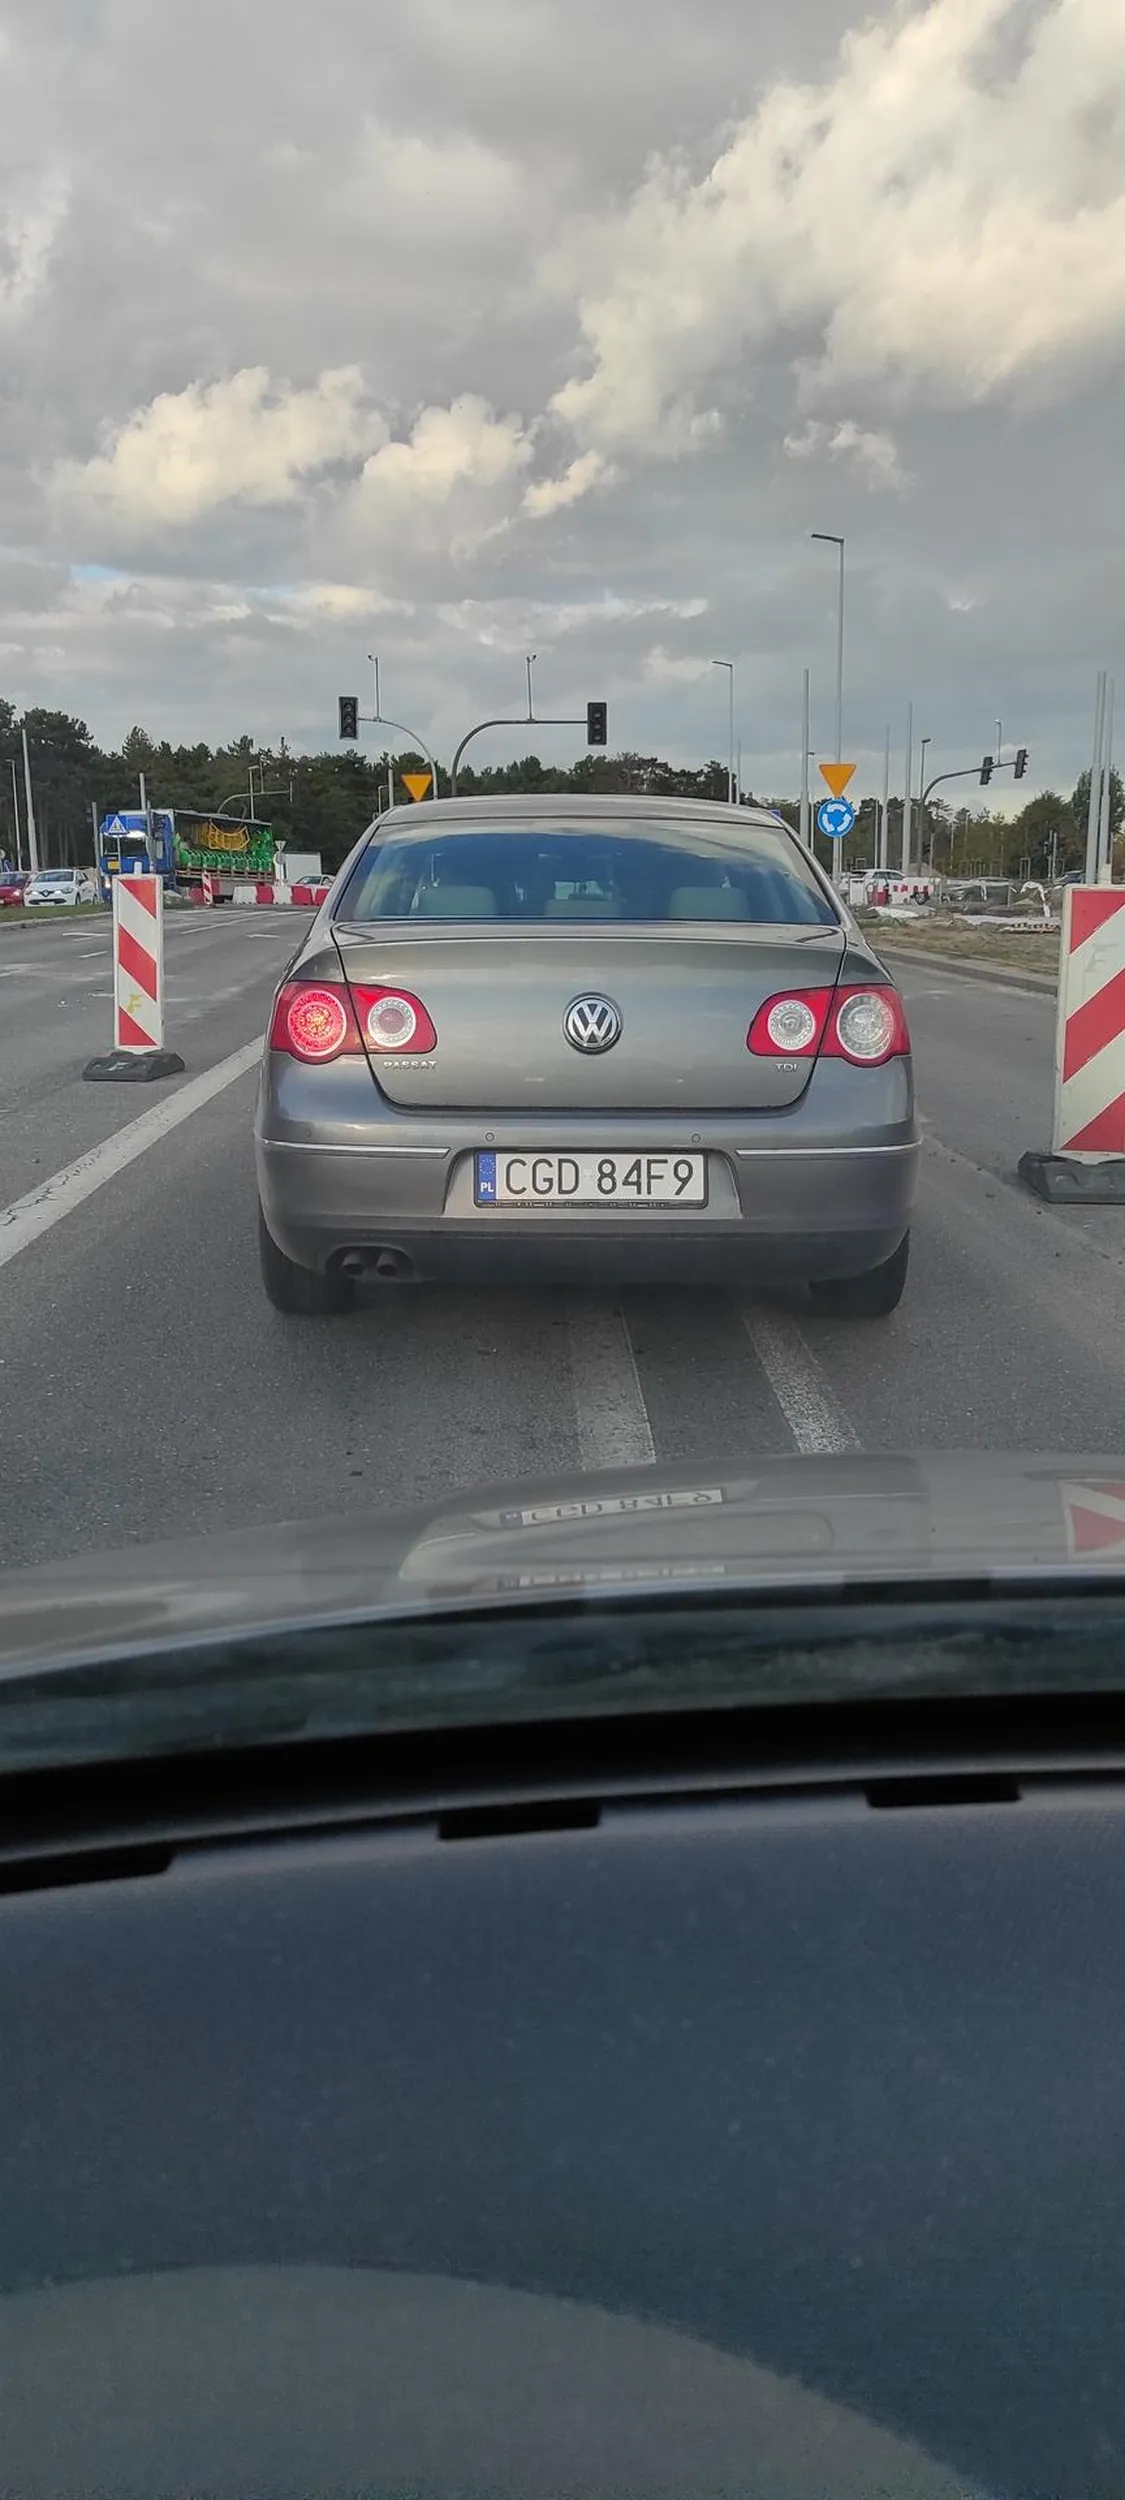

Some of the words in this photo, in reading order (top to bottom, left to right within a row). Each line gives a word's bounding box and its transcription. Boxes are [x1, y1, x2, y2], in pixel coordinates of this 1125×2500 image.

[383, 1060, 437, 1070] PASSAT
[775, 1063, 797, 1072] TDI
[505, 1158, 579, 1196] CGD
[597, 1158, 693, 1196] 84F9
[480, 1183, 494, 1192] PL
